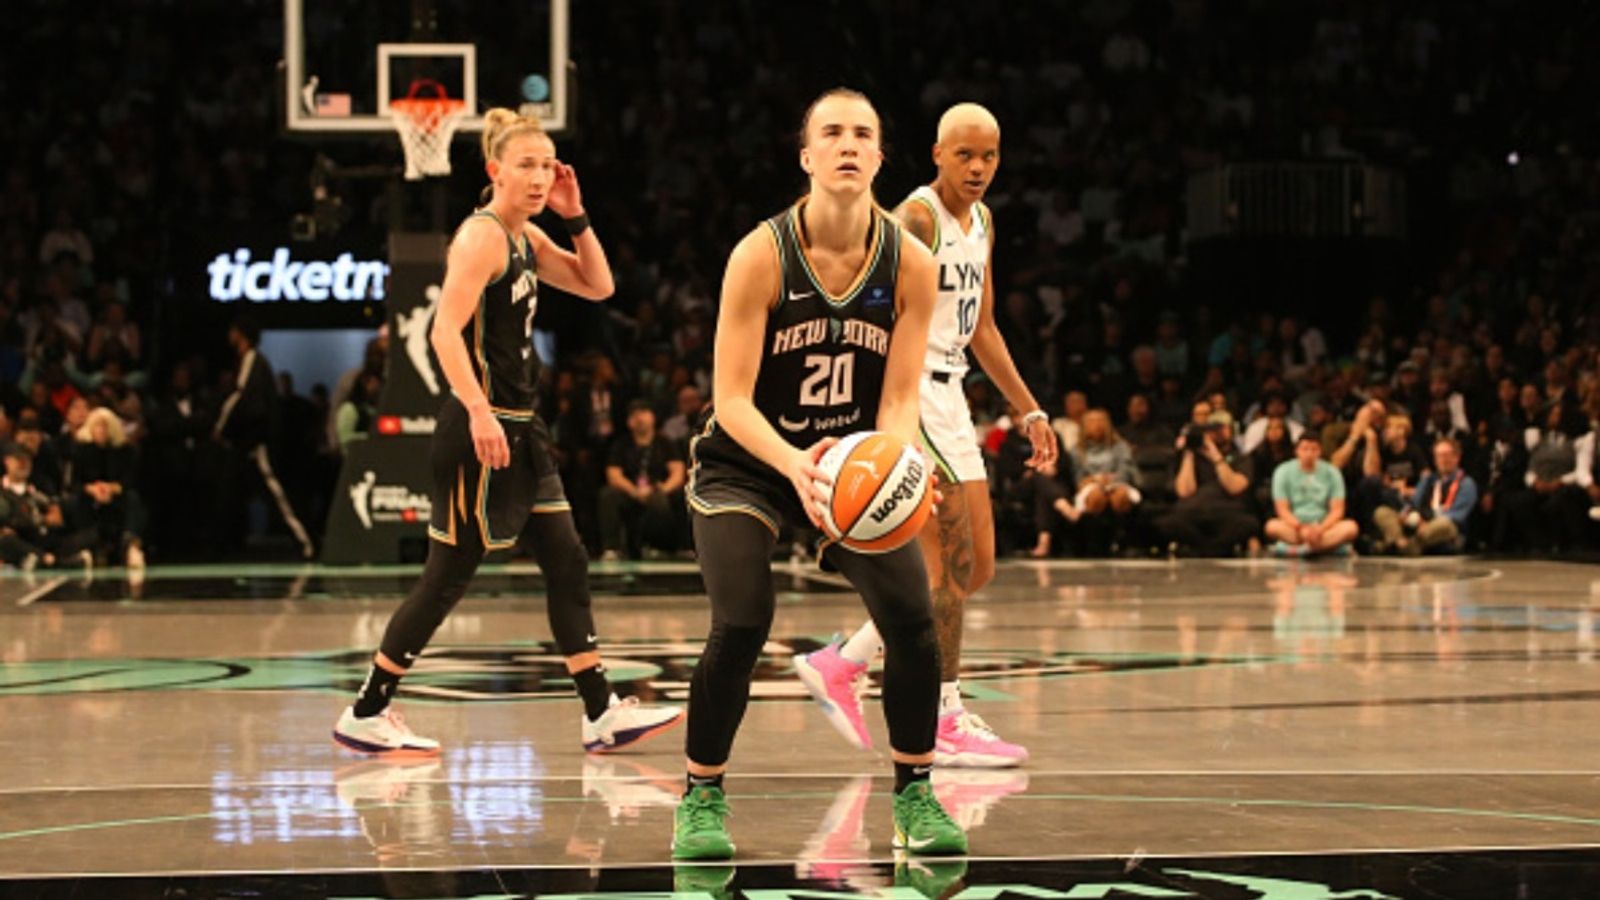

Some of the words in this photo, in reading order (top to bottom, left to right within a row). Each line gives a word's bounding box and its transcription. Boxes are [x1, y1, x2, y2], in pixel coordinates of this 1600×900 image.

[938, 263, 983, 292] LYN
[957, 296, 976, 336] 10
[772, 318, 828, 355] NEW
[800, 352, 854, 406] 20
[870, 459, 922, 524] Wilson
